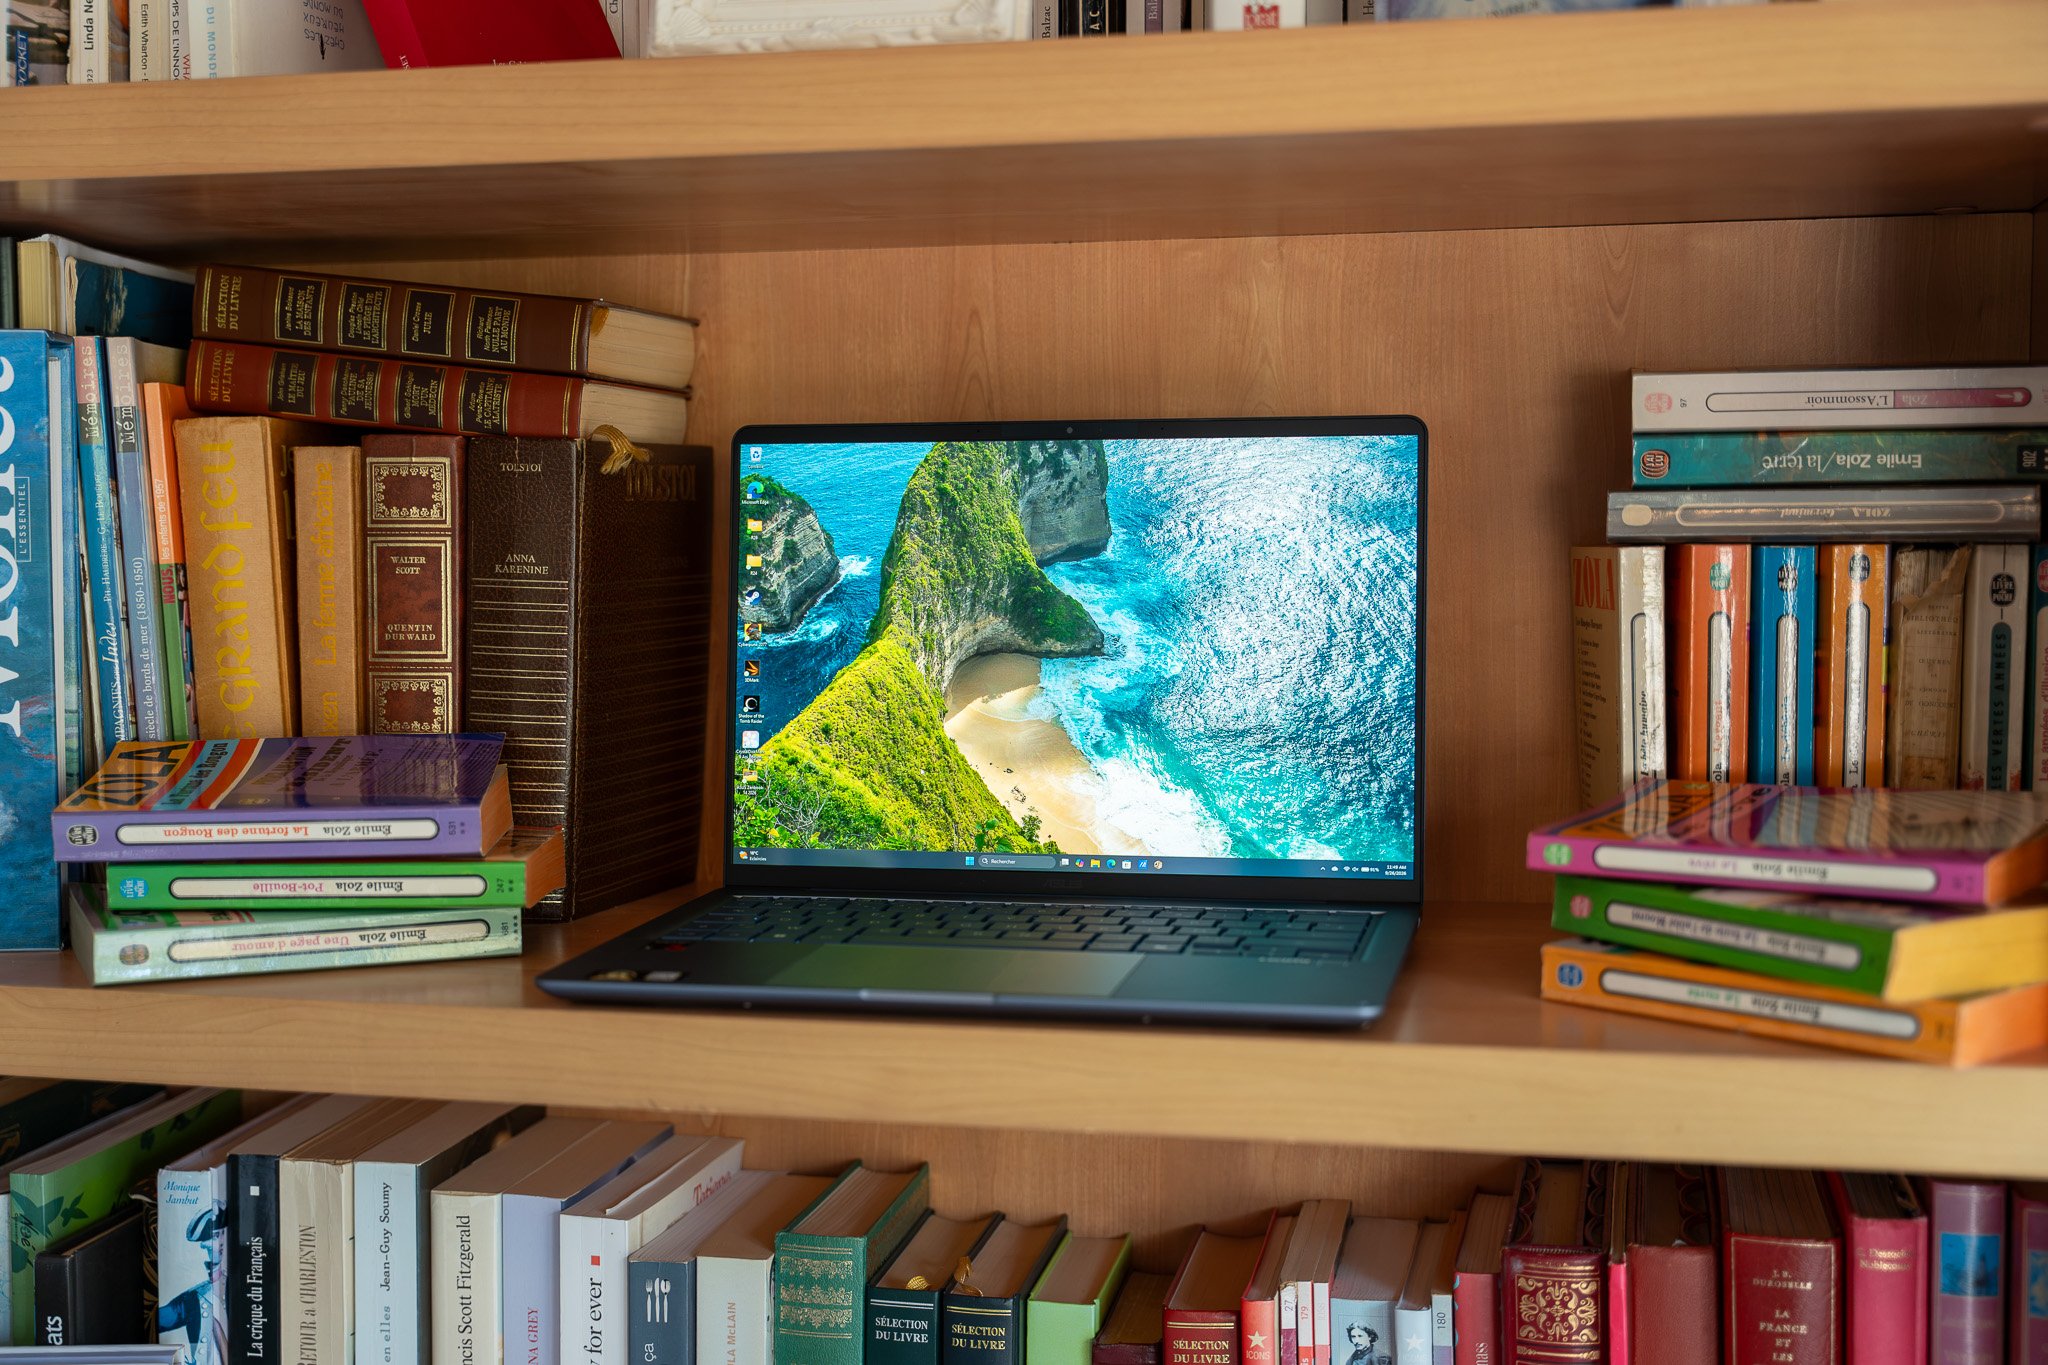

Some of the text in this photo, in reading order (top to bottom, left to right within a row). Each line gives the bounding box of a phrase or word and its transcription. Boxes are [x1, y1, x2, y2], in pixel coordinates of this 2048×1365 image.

[332, 4, 344, 18] DU
[172, 20, 180, 36] DE
[303, 11, 345, 33] HEUREUX
[1041, 6, 1051, 39] Balzac
[84, 17, 94, 50] Linda
[141, 3, 149, 70] Edith Wharton
[206, 7, 217, 79] DU MONDE
[303, 28, 345, 50] CHEZ LES
[217, 274, 230, 330] SÉLECTION
[230, 276, 242, 330] DU LIVRE
[296, 289, 306, 319] MAISON
[305, 285, 315, 320] ENFANTS
[423, 312, 433, 334] JULIE
[492, 306, 503, 353] NULLE PART
[501, 310, 511, 351] AU MONDE
[210, 348, 222, 402] SÉLECTION
[222, 351, 235, 402] DU LIVRE
[81, 345, 100, 439] Mémoires
[115, 344, 135, 445] Mémoires
[365, 371, 375, 411] JEUNESSE
[412, 384, 420, 407] MORT
[1805, 394, 1929, 408] Zola L'Assommoir
[484, 377, 495, 430] LE CAPITAINE
[493, 383, 503, 425] ALATRISTE
[1680, 397, 1687, 408] 97
[500, 462, 542, 473] TOLSTOI
[1762, 453, 1922, 470] Emile terre
[2022, 450, 2038, 468] 902
[155, 478, 165, 499] 1957
[18, 483, 27, 555] L'ESSENTIEL
[159, 502, 167, 515] de
[1851, 507, 1891, 518] ZOLA
[158, 516, 169, 547] enfants
[161, 548, 170, 560] les
[310, 462, 338, 667] La ferme africaine
[390, 556, 426, 565] WALTER
[506, 554, 536, 563] ANNA
[395, 566, 421, 576] SCOTT
[494, 565, 548, 576] KARENINE
[1573, 556, 1616, 611] ZOLA
[1992, 581, 2016, 590] LIVRE
[385, 633, 436, 641] DURWARD
[387, 624, 433, 632] QUENTIN
[100, 620, 120, 664] Indes
[132, 556, 157, 741] siècle de bords de mer (1850-1950)
[1990, 632, 2007, 790] LES VERTES ANNÉES
[2038, 760, 2047, 783] Les
[163, 824, 392, 838] Émile Zola La fortune des Rougon
[449, 821, 457, 835] 531
[990, 858, 1016, 866] Rechercher
[252, 881, 403, 893] Émile Zola Pot-Bouille
[497, 878, 505, 894] 247
[231, 929, 427, 951] Émile Zola Une page d'amour
[163, 1180, 200, 1193] Monique
[691, 1171, 732, 1206] Tatiana
[165, 1194, 199, 1206] Jambut
[379, 1182, 393, 1292] Jean-Guy Soumy
[298, 1223, 317, 1306] CHARLESTON
[456, 1214, 475, 1333] Scott Fitzgerald
[246, 1236, 268, 1358] La crique du Français
[1284, 1299, 1294, 1312] 27
[527, 1306, 541, 1341] GREY
[584, 1277, 603, 1356] for ever
[726, 1301, 737, 1342] McLAIN
[875, 1315, 929, 1331] SÉLECTION
[1300, 1305, 1309, 1321] 179
[1437, 1311, 1447, 1330] 180
[1775, 1309, 1790, 1319] LA
[47, 1315, 63, 1346] ats
[376, 1305, 391, 1363] en elles
[875, 1330, 929, 1343] DU LIVRE
[951, 1322, 1006, 1338] SÉLECTION
[1759, 1322, 1809, 1335] FRANCE
[645, 1342, 657, 1362] ça
[951, 1337, 1006, 1350] DU LIVRE
[1173, 1336, 1230, 1351] SÉLECTION
[1775, 1338, 1791, 1348] ET
[1173, 1352, 1231, 1365] DU LIVRE
[1245, 1350, 1271, 1361] ICONS
[1772, 1352, 1794, 1363] LES
